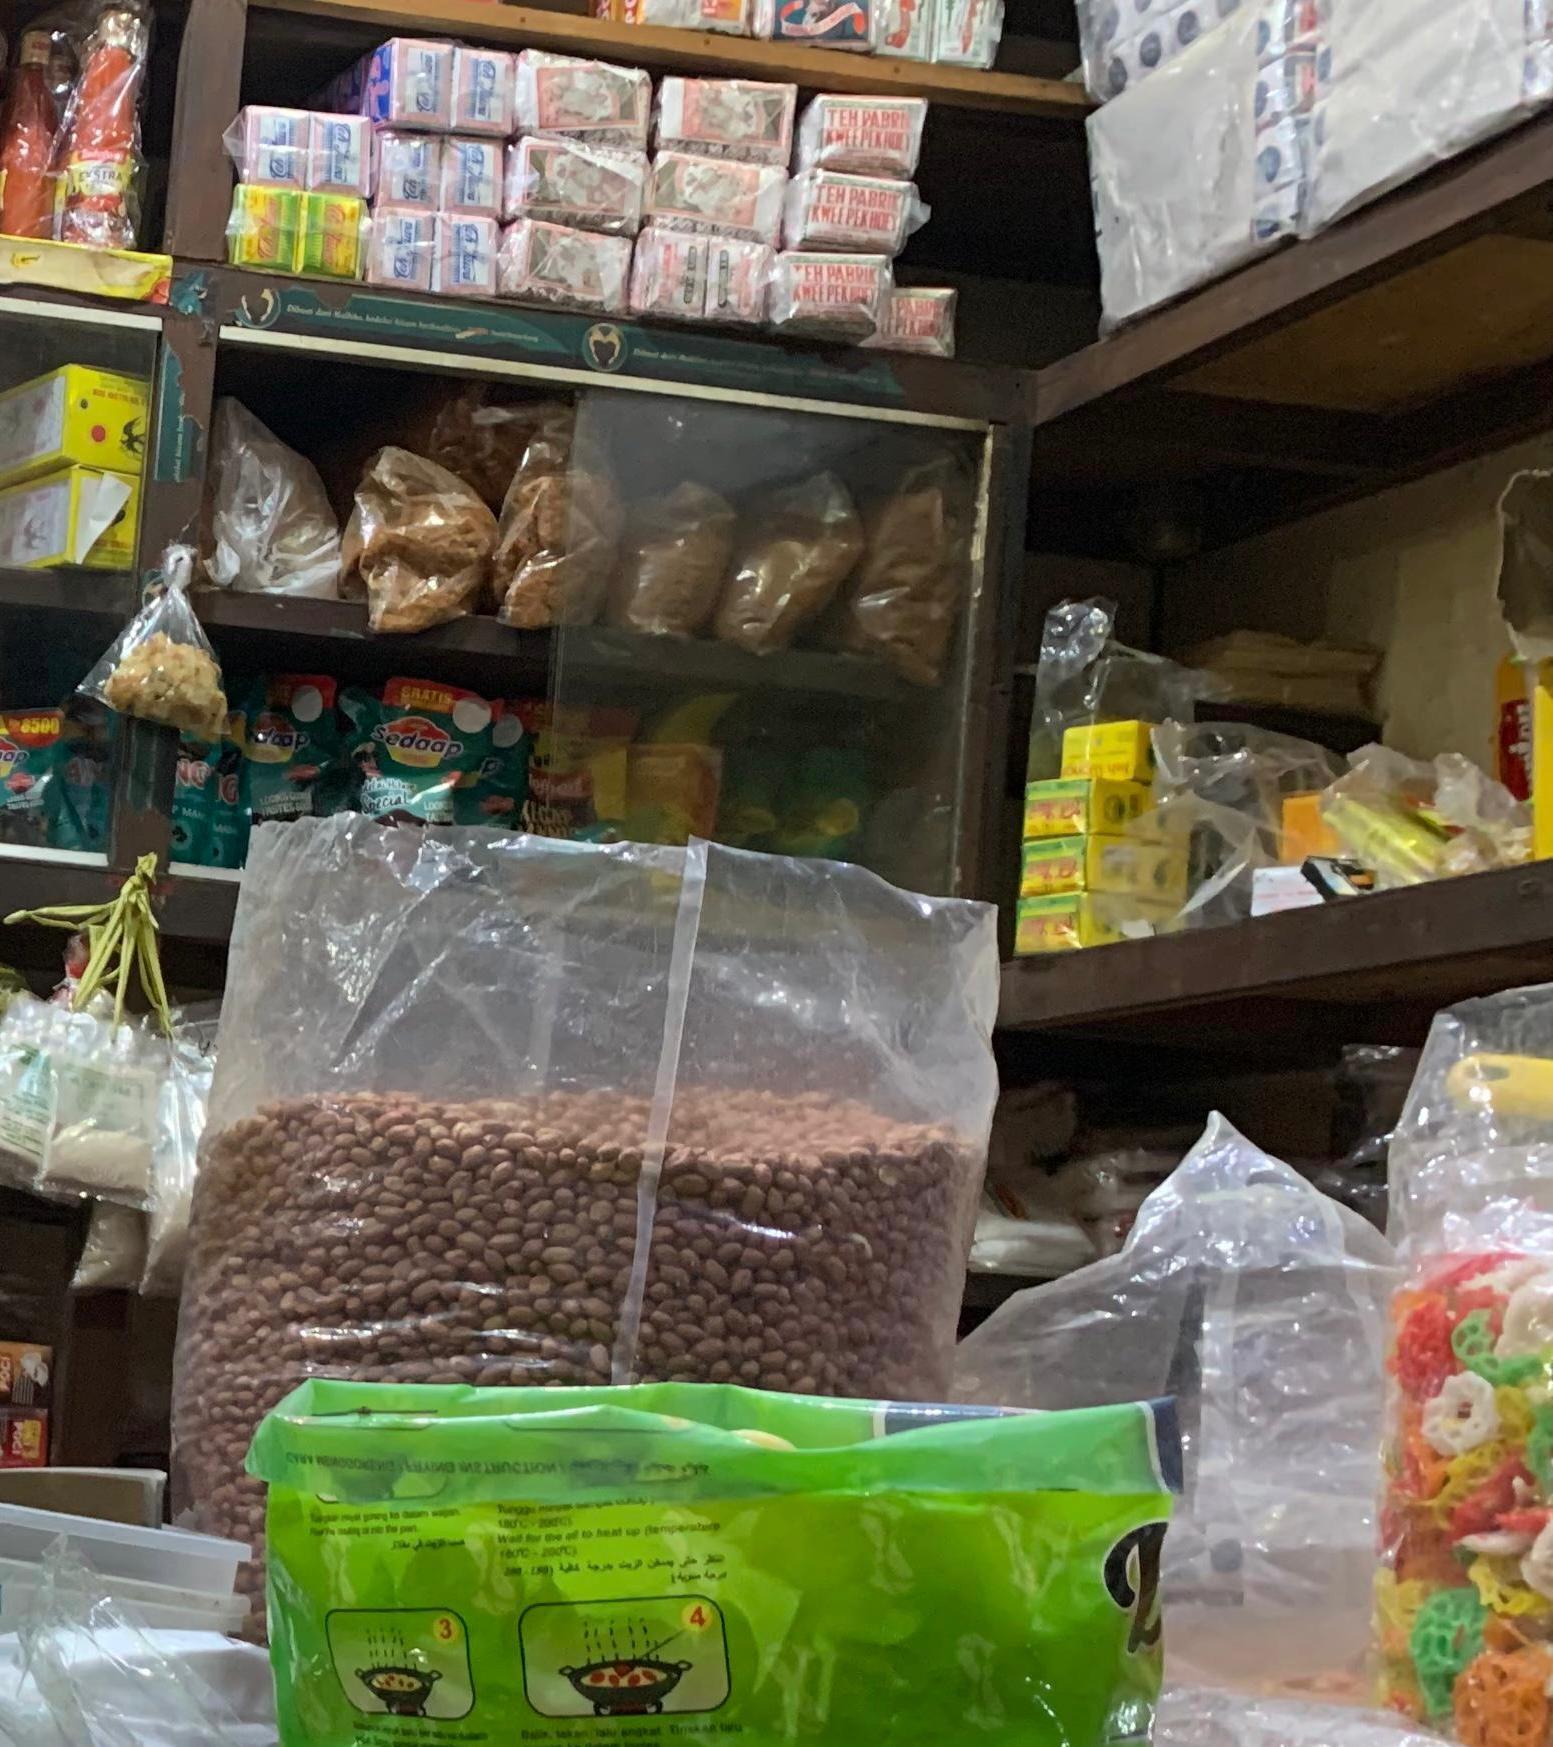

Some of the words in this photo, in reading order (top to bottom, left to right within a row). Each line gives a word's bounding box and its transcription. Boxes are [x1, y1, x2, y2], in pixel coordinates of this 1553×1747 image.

[827, 109, 858, 127] TEH
[816, 184, 846, 204] TEH
[371, 723, 465, 760] Sedaap
[689, 1604, 705, 1628] 4
[438, 1617, 453, 1640] 3
